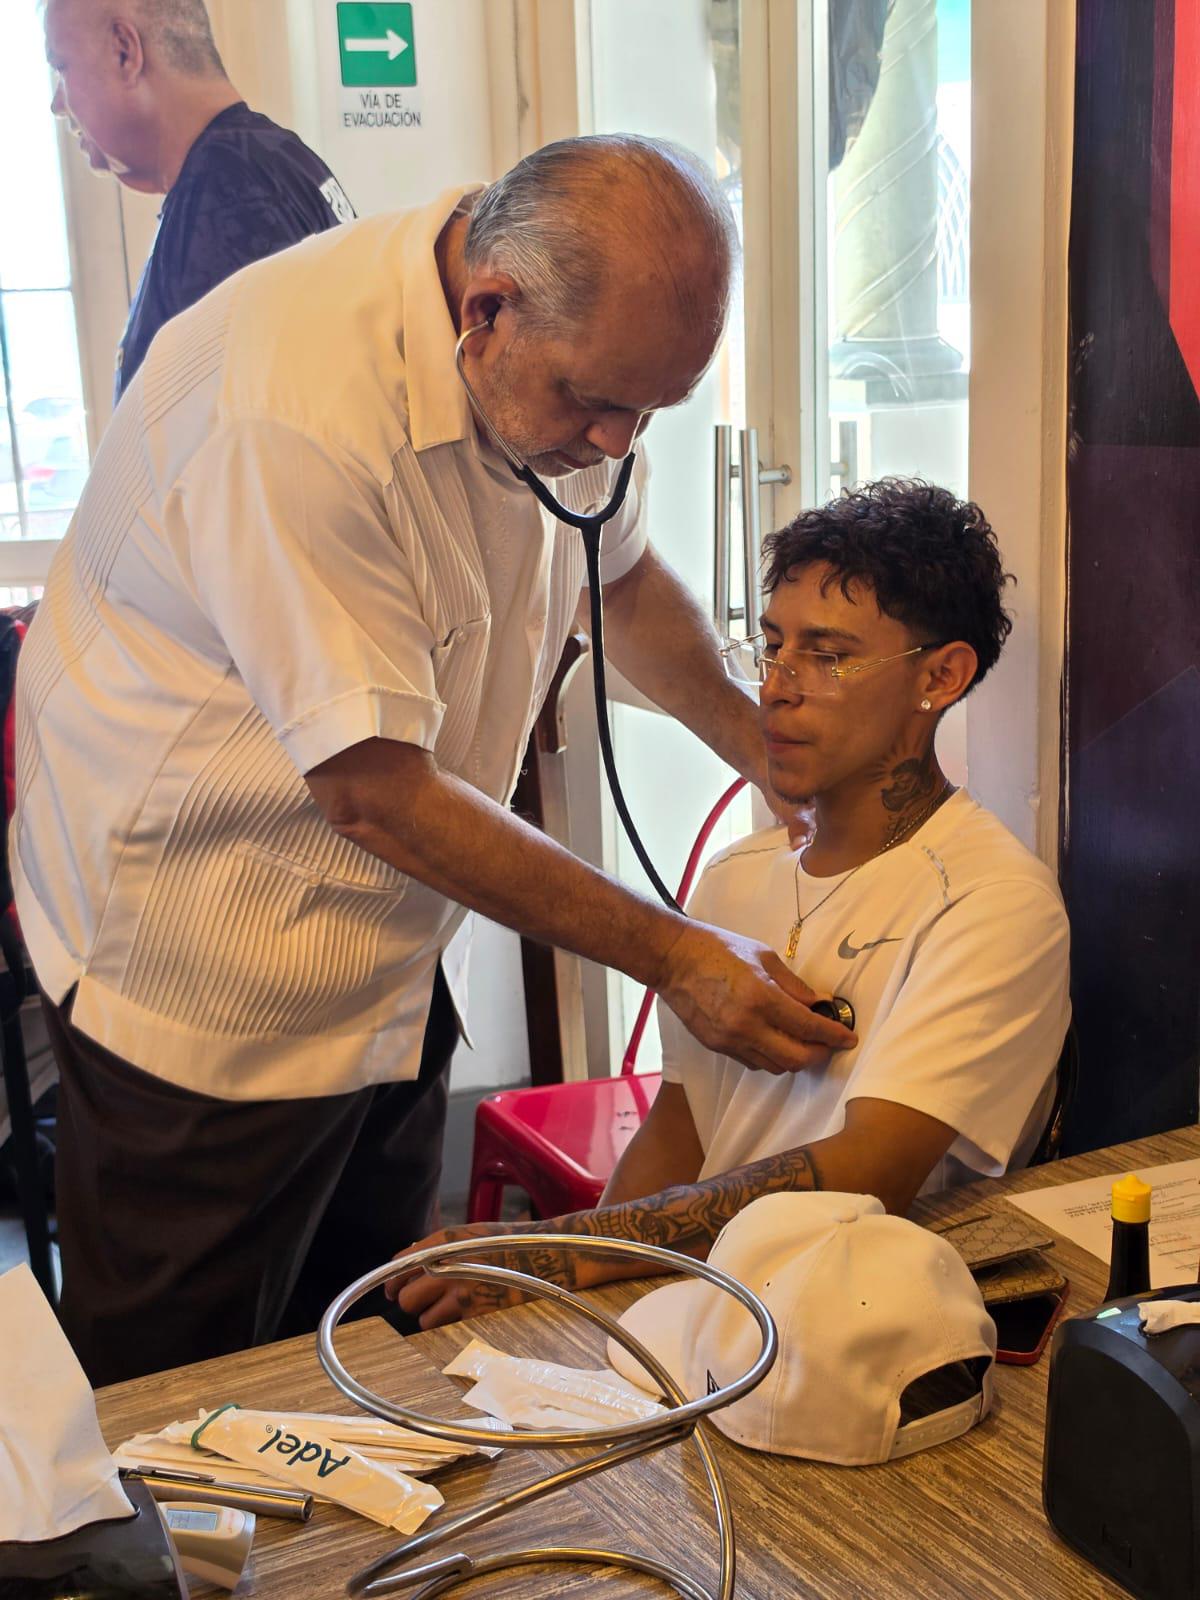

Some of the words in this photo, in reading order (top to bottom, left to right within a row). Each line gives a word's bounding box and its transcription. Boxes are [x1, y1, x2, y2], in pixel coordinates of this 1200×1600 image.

[360, 90, 381, 108] VÍA
[385, 93, 402, 108] DE
[343, 108, 422, 127] EVACUACIÓN
